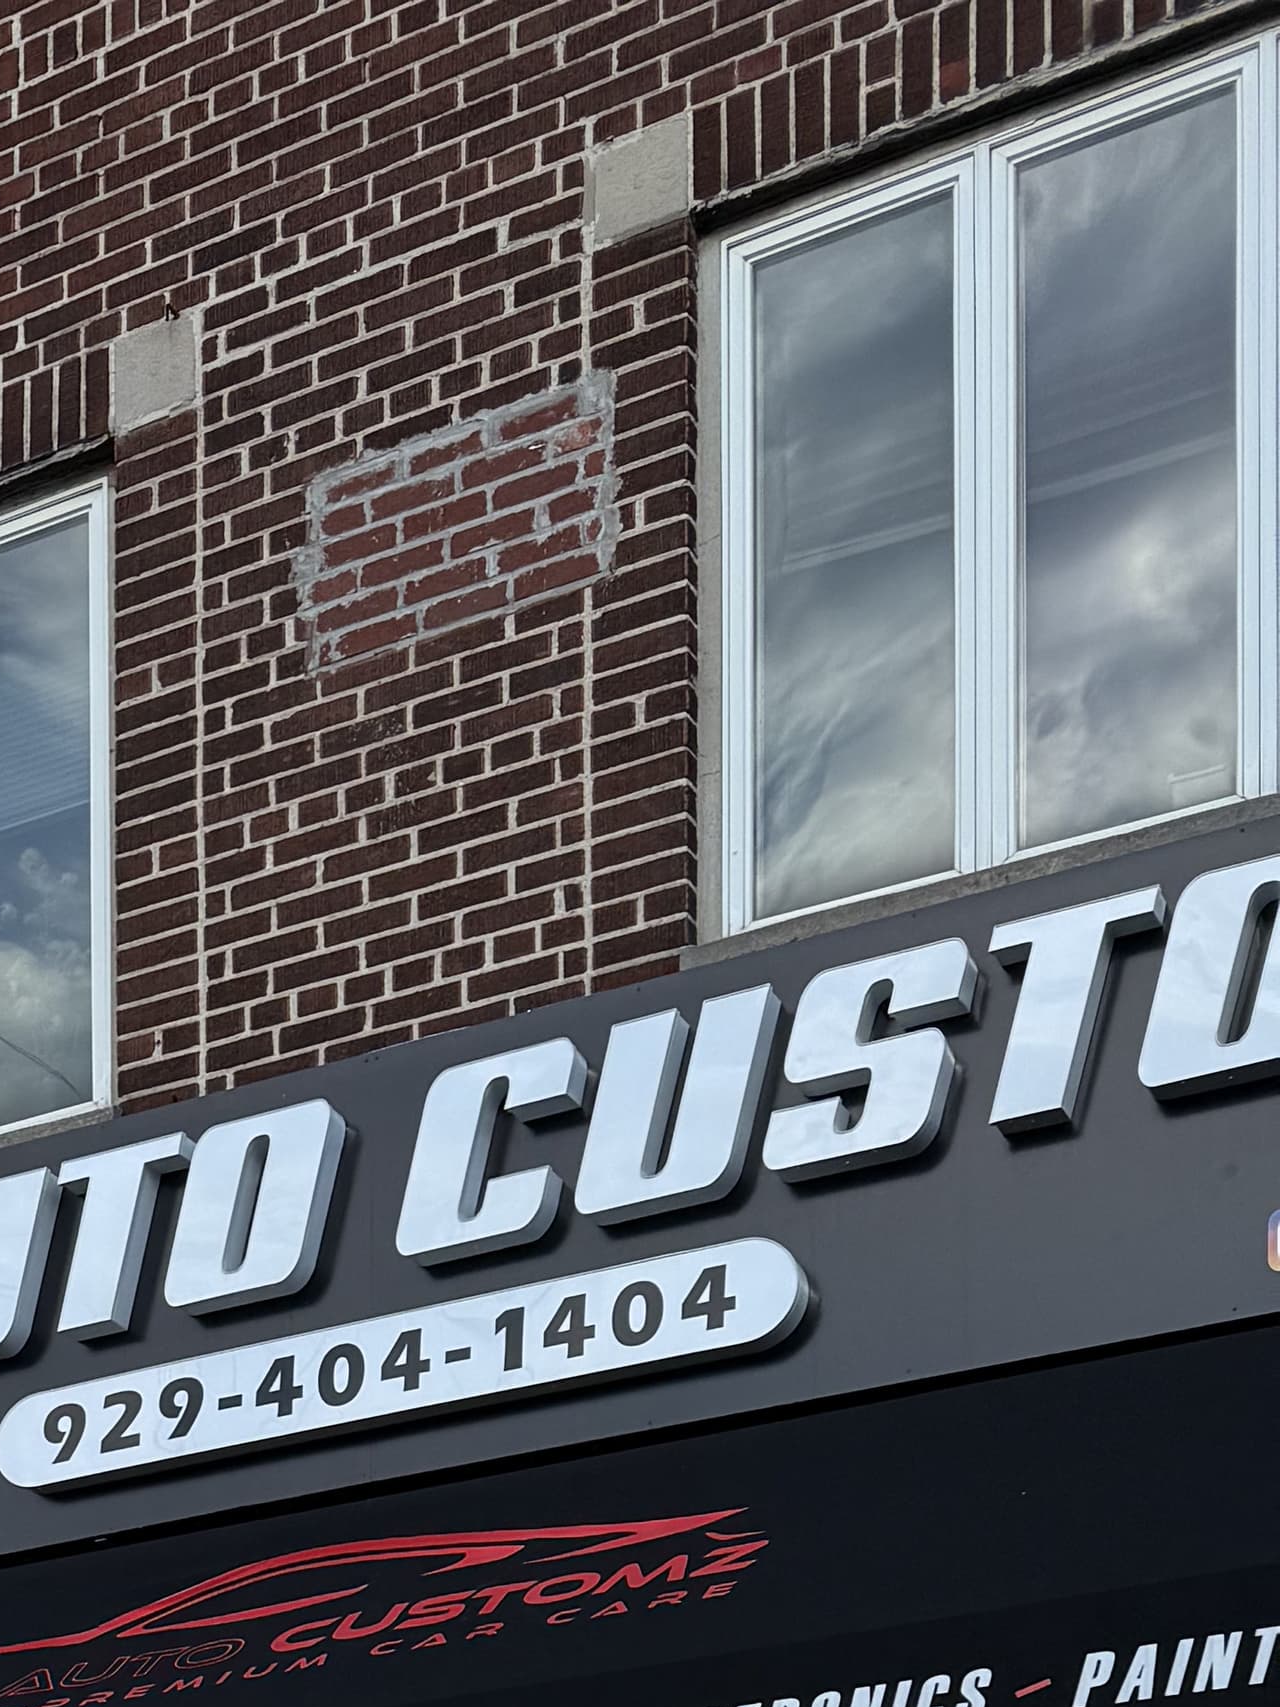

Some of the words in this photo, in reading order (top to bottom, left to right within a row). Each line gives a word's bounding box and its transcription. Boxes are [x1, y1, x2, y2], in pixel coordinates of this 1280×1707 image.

[42, 1265, 736, 1464] 929-404-1404
[370, 1622, 504, 1656] CAR
[546, 1581, 738, 1625] CARE
